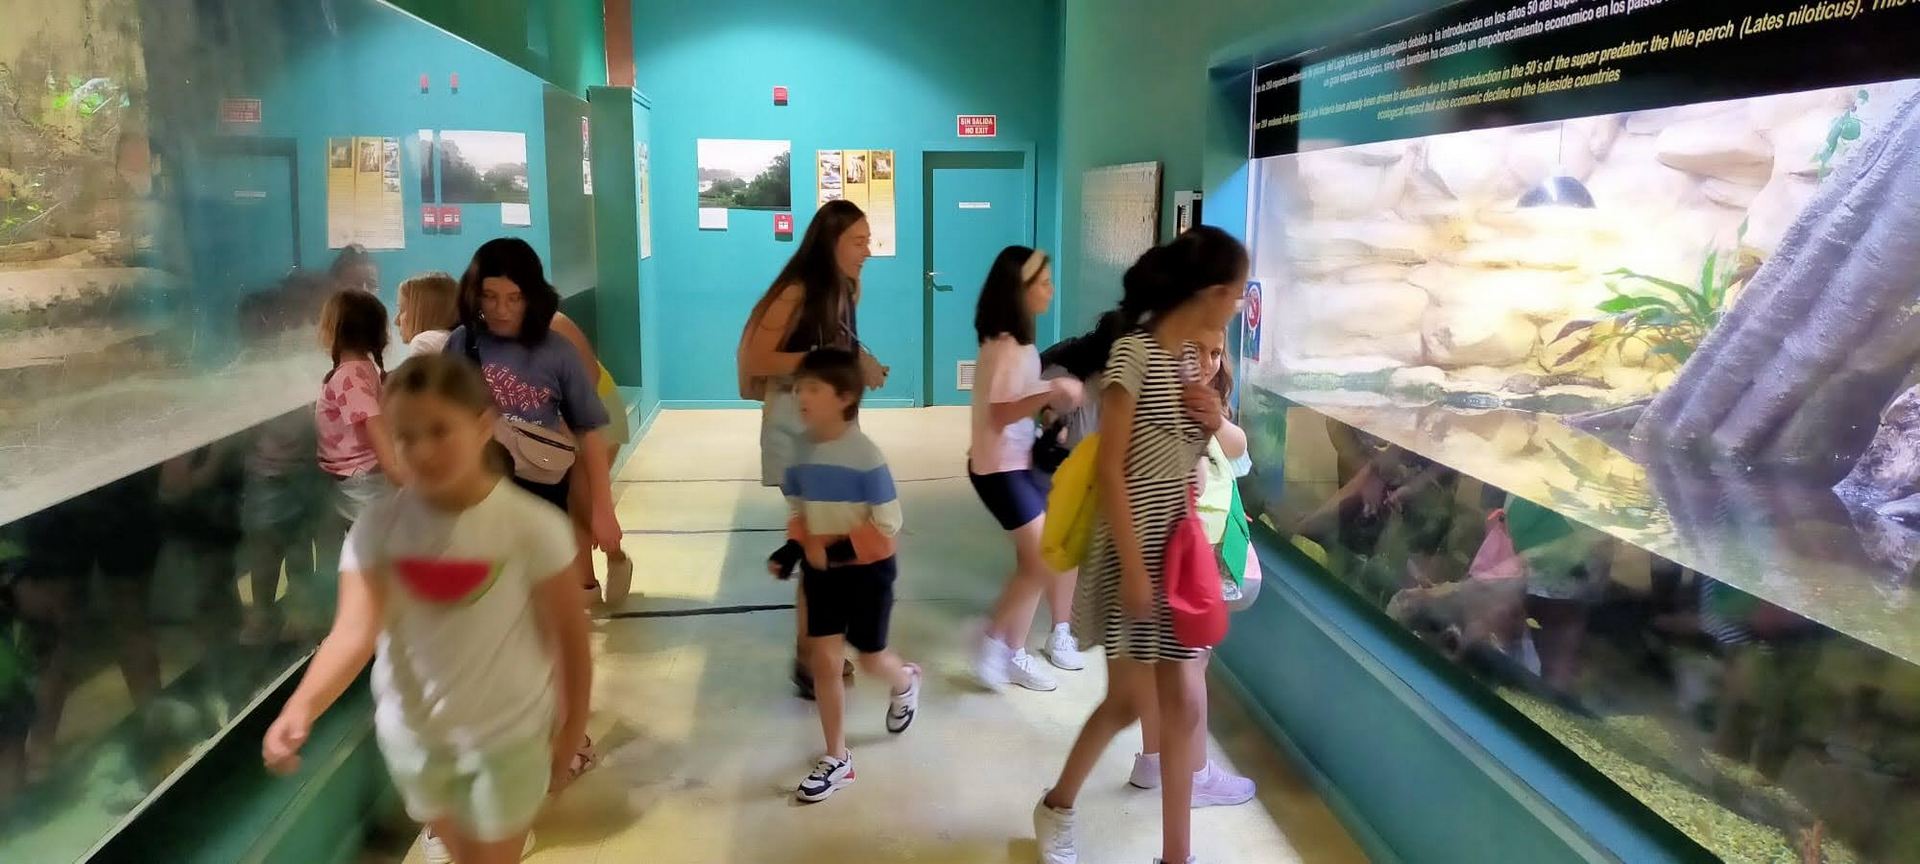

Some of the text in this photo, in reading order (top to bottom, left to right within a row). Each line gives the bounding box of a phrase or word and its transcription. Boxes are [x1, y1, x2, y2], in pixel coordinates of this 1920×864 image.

[1335, 103, 1346, 113] have
[1346, 100, 1362, 111] already
[1363, 97, 1377, 107] been
[1392, 90, 1400, 100] to
[1400, 85, 1428, 99] extinction
[1428, 82, 1440, 93] due
[1440, 80, 1447, 92] to
[1448, 77, 1459, 90] the
[1459, 69, 1502, 88] introduction
[1502, 66, 1510, 80] in
[1511, 63, 1525, 78] the
[1543, 56, 1556, 72] of
[1555, 55, 1570, 70] the
[1570, 50, 1599, 68] super
[1599, 40, 1648, 65] predator:
[1650, 34, 1669, 52] the
[1671, 29, 1695, 49] Nile
[1695, 19, 1734, 48] perch
[1740, 12, 1784, 40] (Lates
[1786, 0, 1864, 27] niloticus).
[1346, 52, 1364, 67] Victoria
[1364, 51, 1370, 61] se
[1370, 48, 1380, 59] han
[1380, 40, 1407, 55] extinguido
[1408, 32, 1428, 48] debido
[1428, 33, 1433, 43] a
[1435, 29, 1441, 41] la
[1442, 17, 1483, 39] introducción
[1484, 14, 1493, 27] en
[1494, 11, 1506, 24] los
[1507, 6, 1526, 20] años
[1527, 1, 1538, 15] 50
[1539, 0, 1553, 10] del
[1554, 0, 1578, 9] supe
[1384, 59, 1395, 71] sino
[1395, 57, 1406, 70] que
[1406, 49, 1430, 66] también
[1430, 47, 1439, 60] ha
[1439, 40, 1467, 57] causado
[1467, 39, 1477, 51] un
[1477, 20, 1544, 48] empobrecimiento
[1544, 8, 1595, 31] economico
[1595, 5, 1609, 19] en
[1609, 0, 1626, 15] los
[1377, 67, 1621, 120] ecological impact but also economic decline on the lakeside countries
